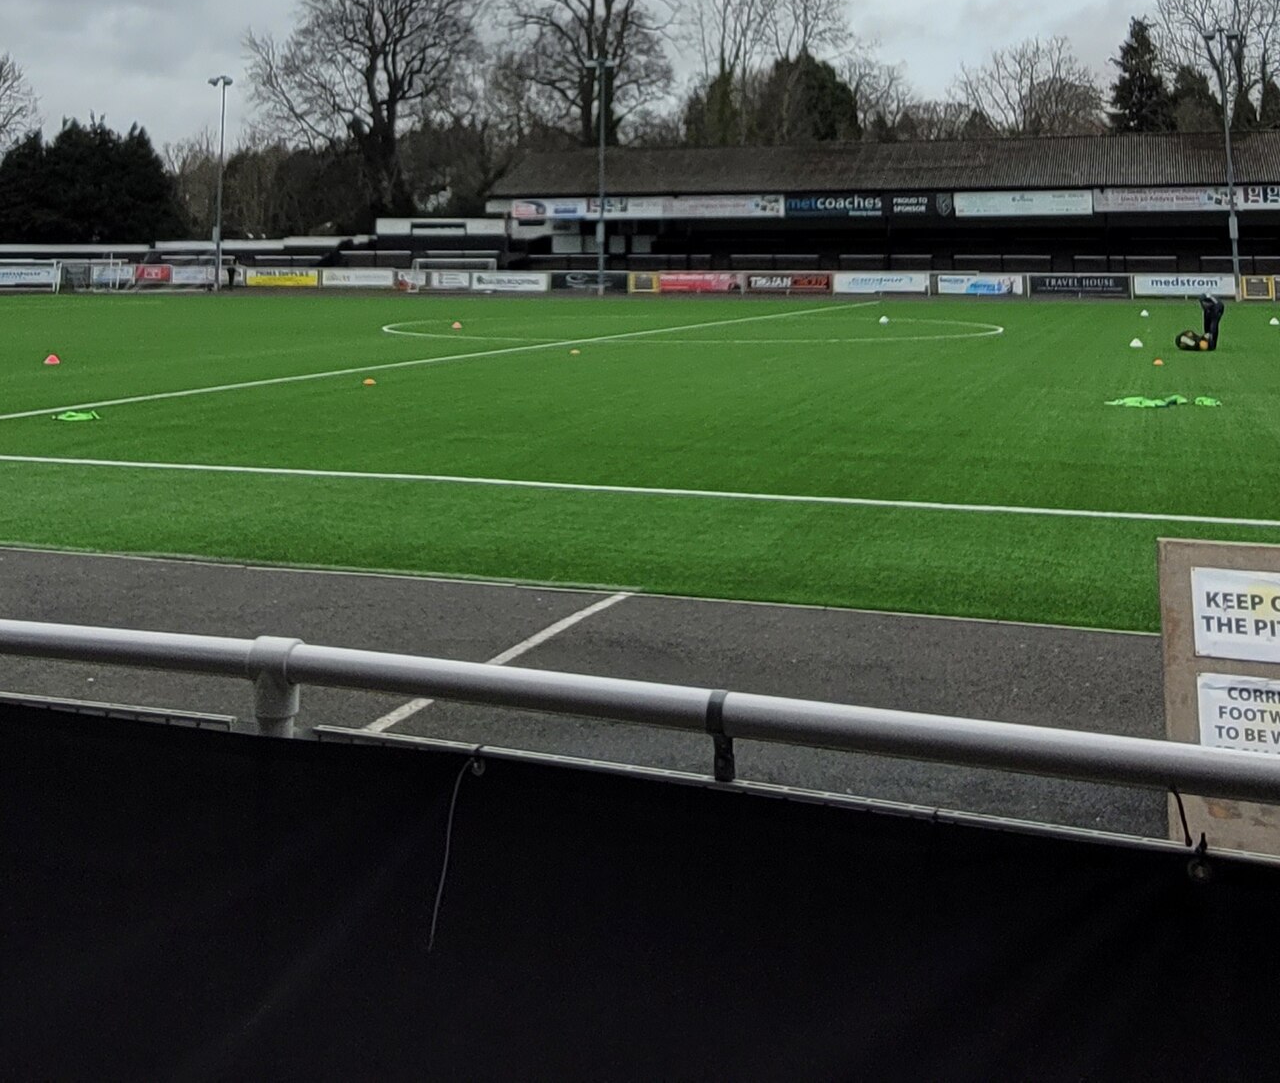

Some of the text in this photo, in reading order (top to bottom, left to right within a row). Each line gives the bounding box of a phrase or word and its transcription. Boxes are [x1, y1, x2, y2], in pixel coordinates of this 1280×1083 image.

[786, 195, 928, 210] metcoaches PROUD TO
[893, 204, 927, 213] SPONSOR
[749, 276, 792, 288] TROJAN
[1045, 277, 1114, 287] TRAVEL HOUSE
[1151, 277, 1218, 287] medstrom
[1205, 591, 1264, 611] KEEP
[1201, 615, 1248, 635] THE
[1215, 725, 1239, 741] TO
[1244, 727, 1267, 743] BE
